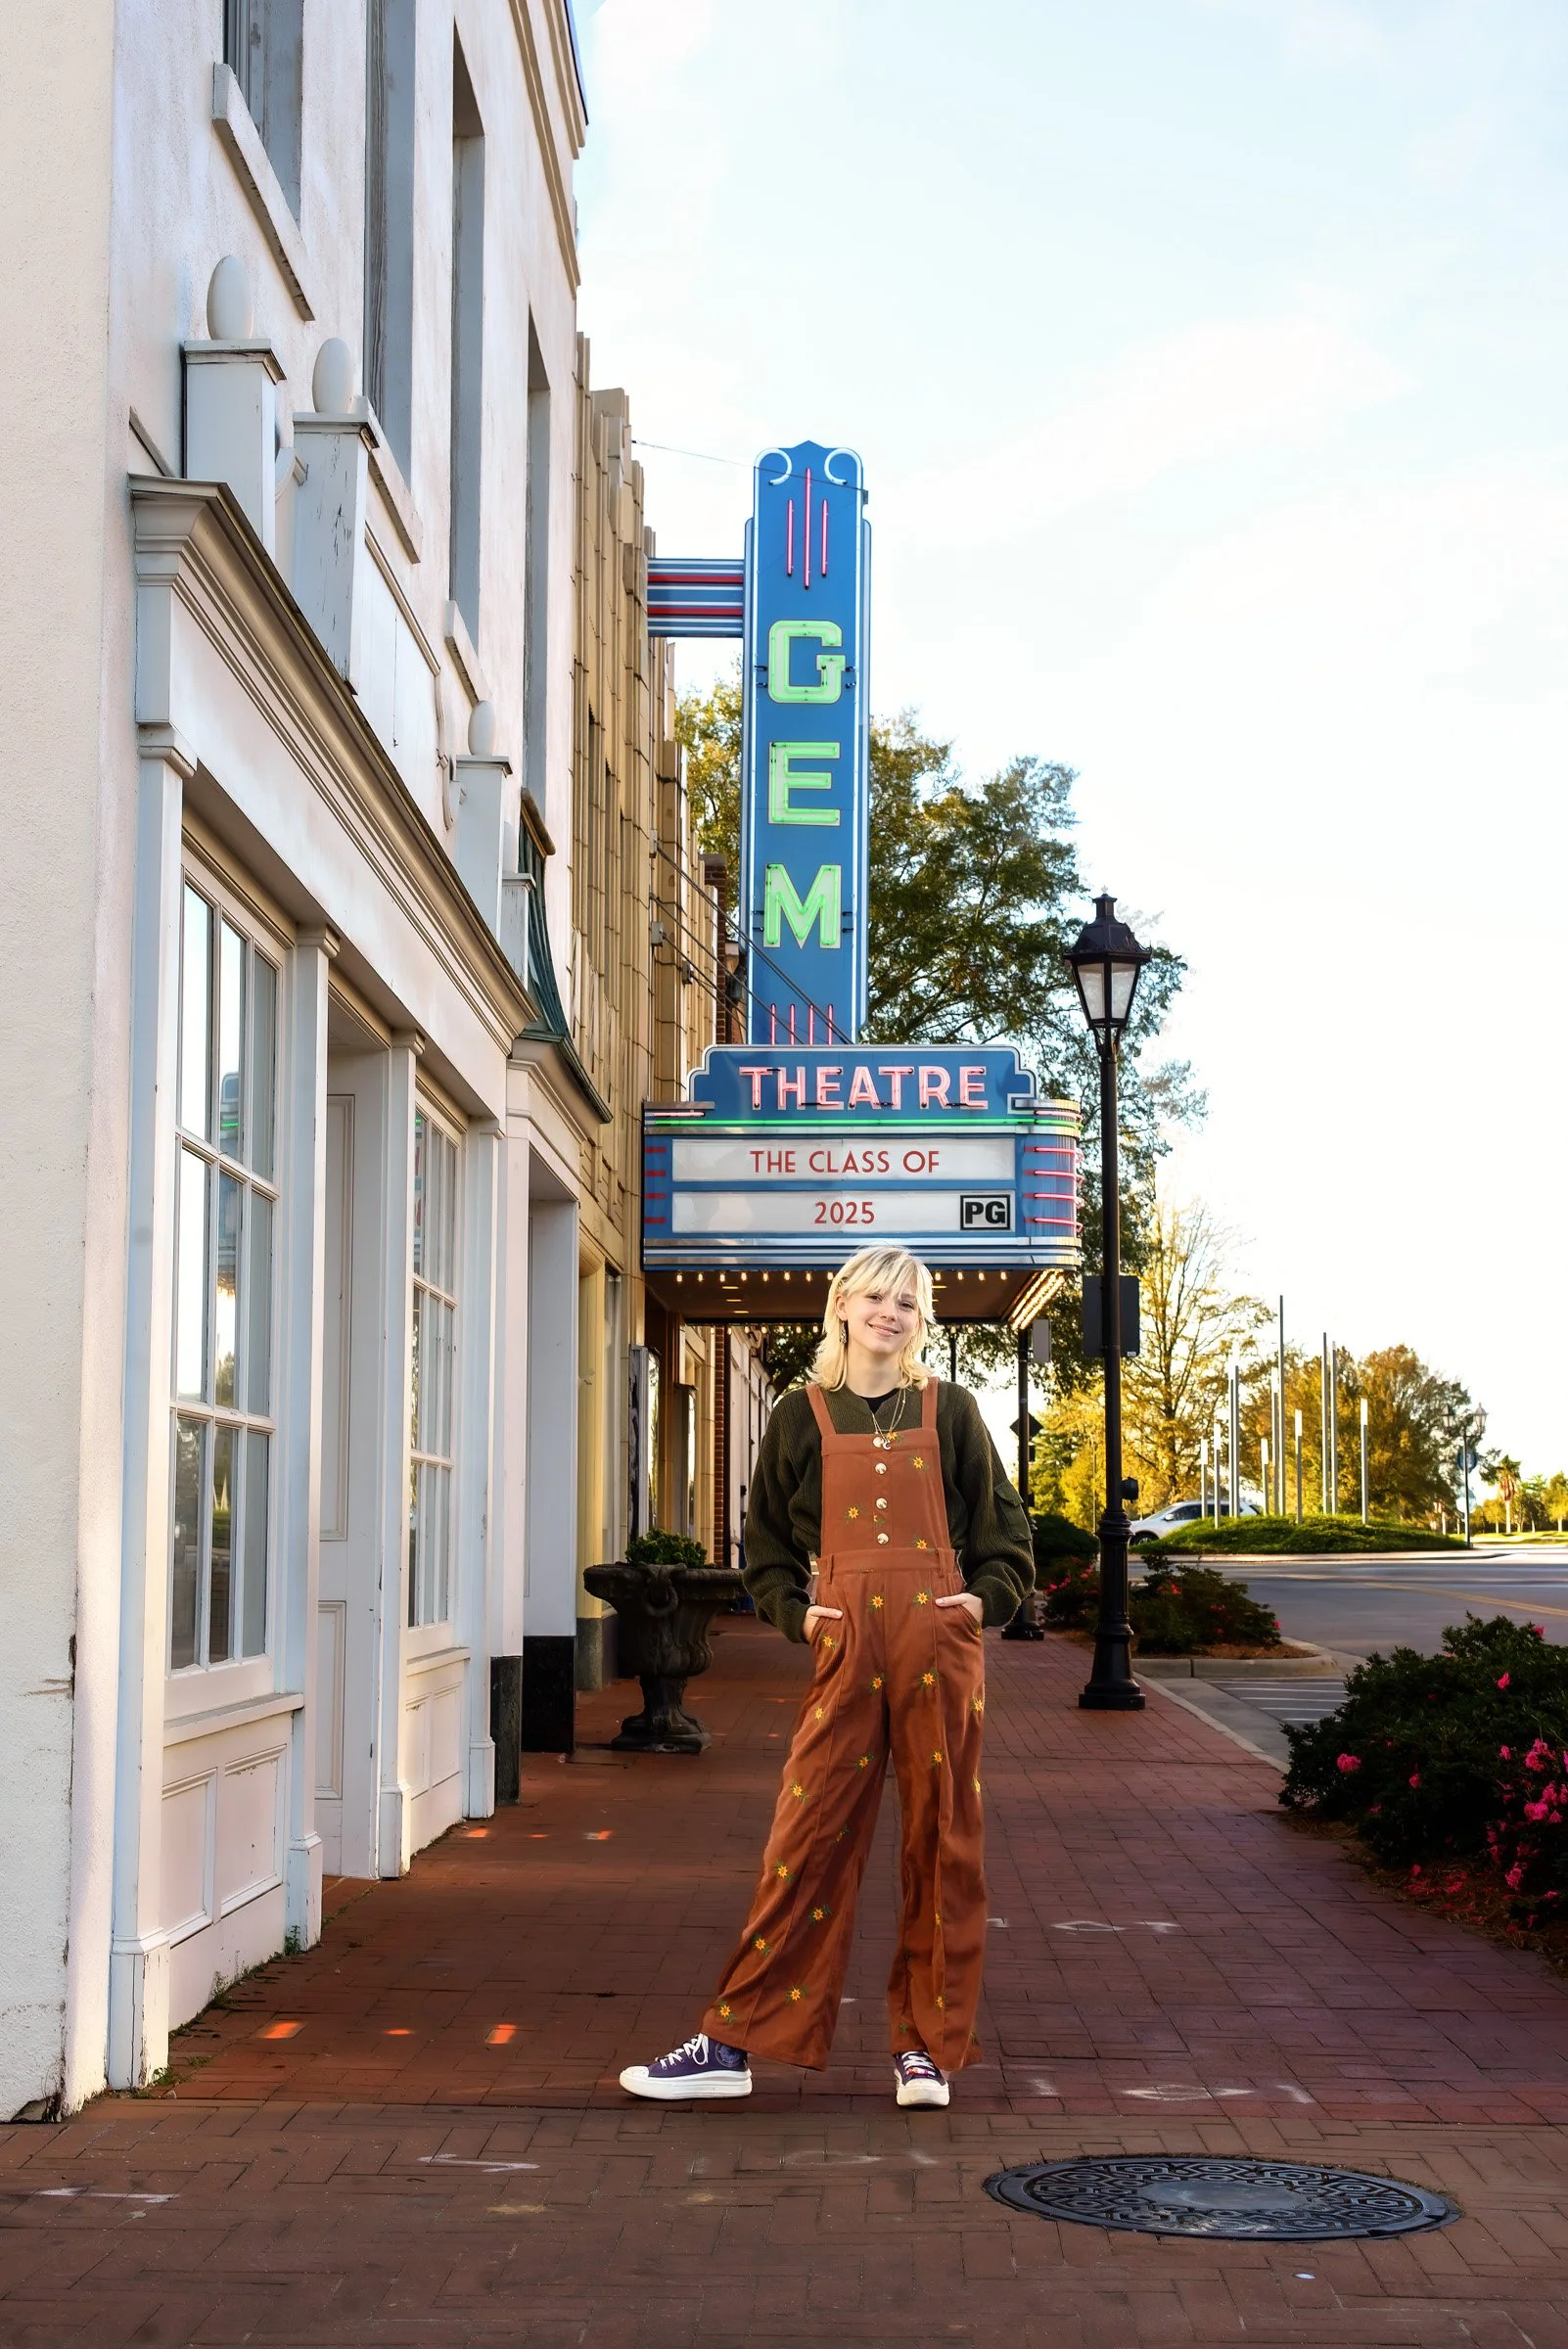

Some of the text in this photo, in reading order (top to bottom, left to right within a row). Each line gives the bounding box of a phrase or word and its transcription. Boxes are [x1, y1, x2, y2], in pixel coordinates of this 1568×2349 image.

[763, 620, 846, 949] GEM
[739, 1065, 989, 1111] THEATRE
[750, 1150, 940, 1174] THE CLASS OF
[813, 1201, 875, 1224] 2025
[964, 1200, 1006, 1224] PG
